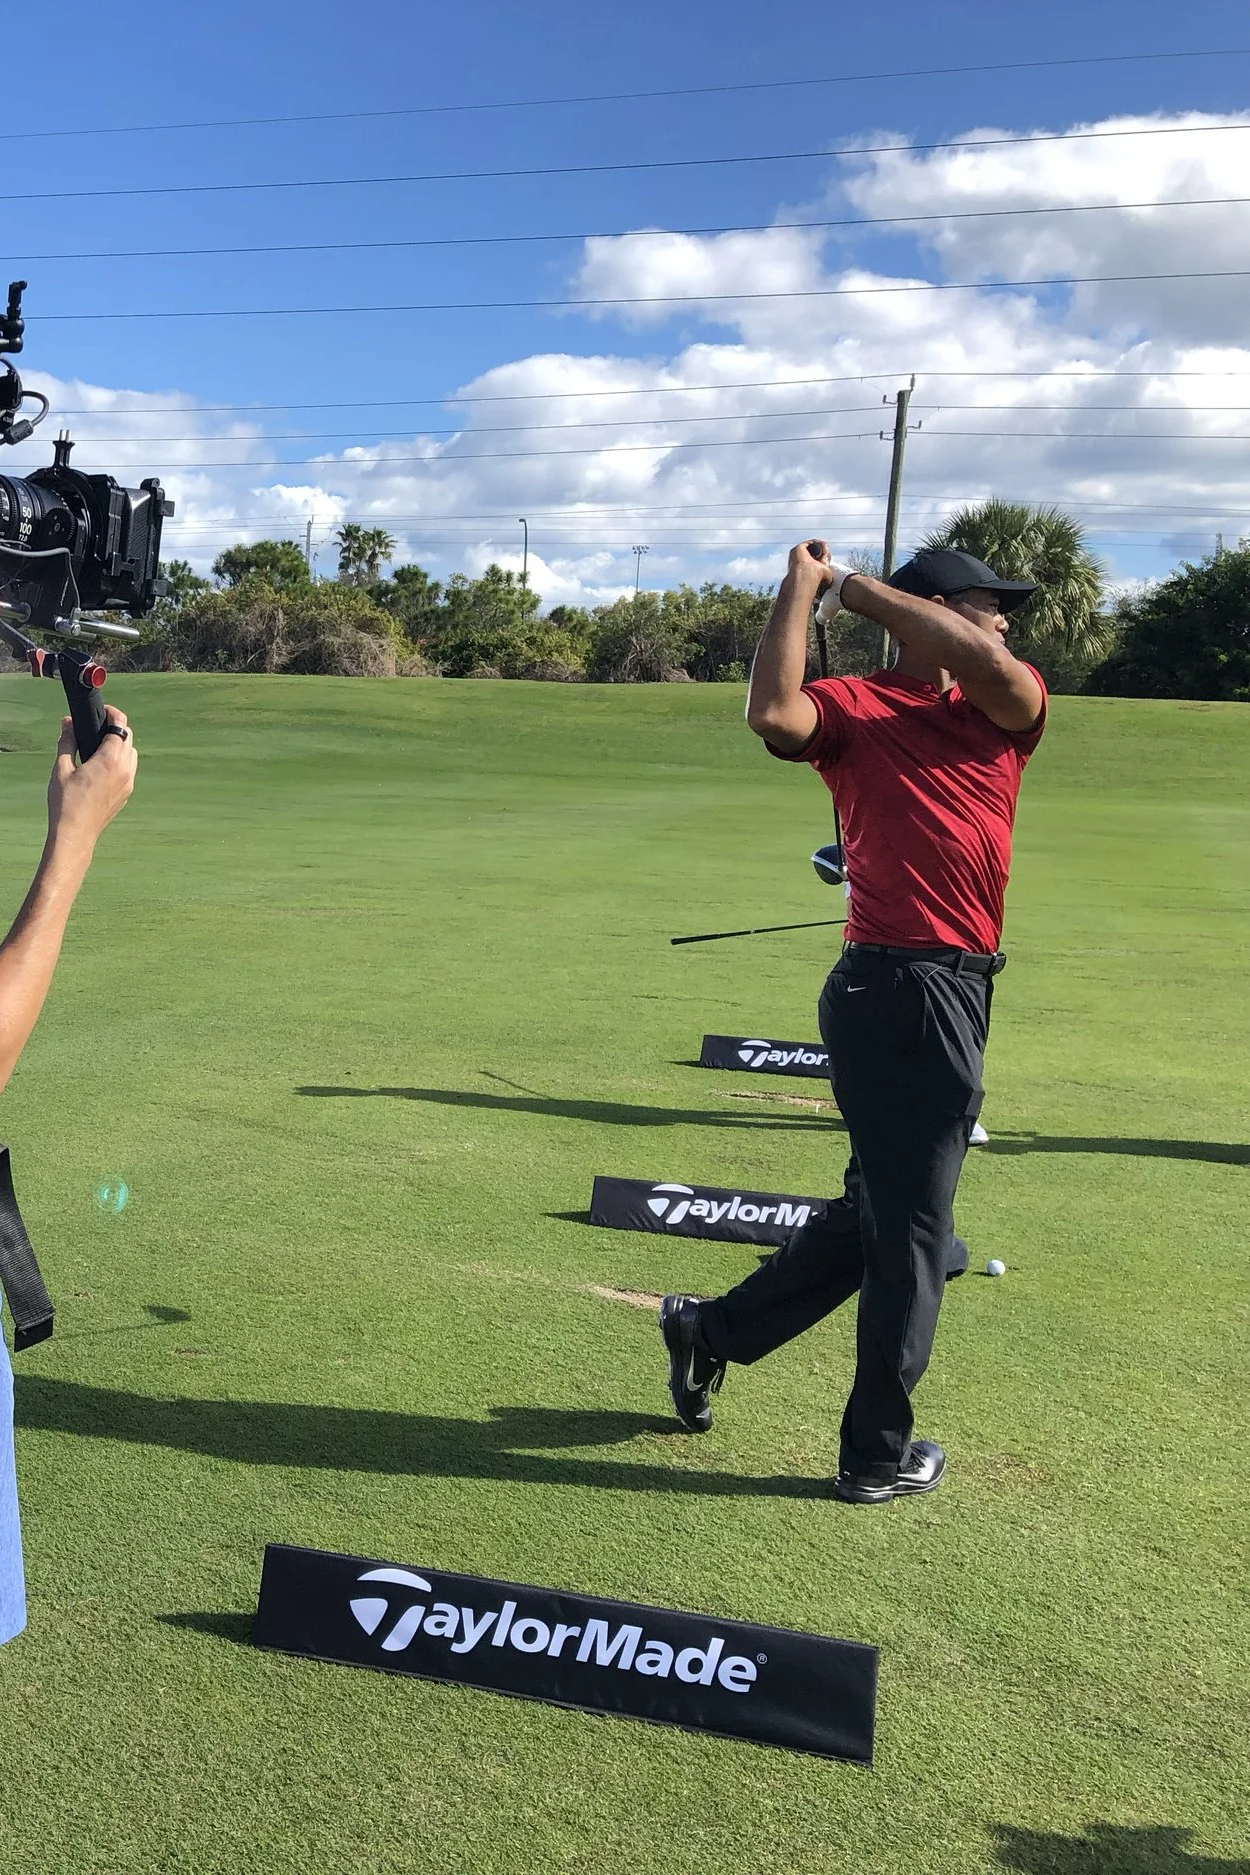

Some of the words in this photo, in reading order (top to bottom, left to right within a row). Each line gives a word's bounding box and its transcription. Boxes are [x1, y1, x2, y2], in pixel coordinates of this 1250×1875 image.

[22, 506, 32, 519] 50
[20, 522, 32, 535] 100
[737, 1040, 829, 1067] Taylor
[647, 1183, 819, 1228] TaylorM
[349, 1568, 758, 1693] TaylorMade
